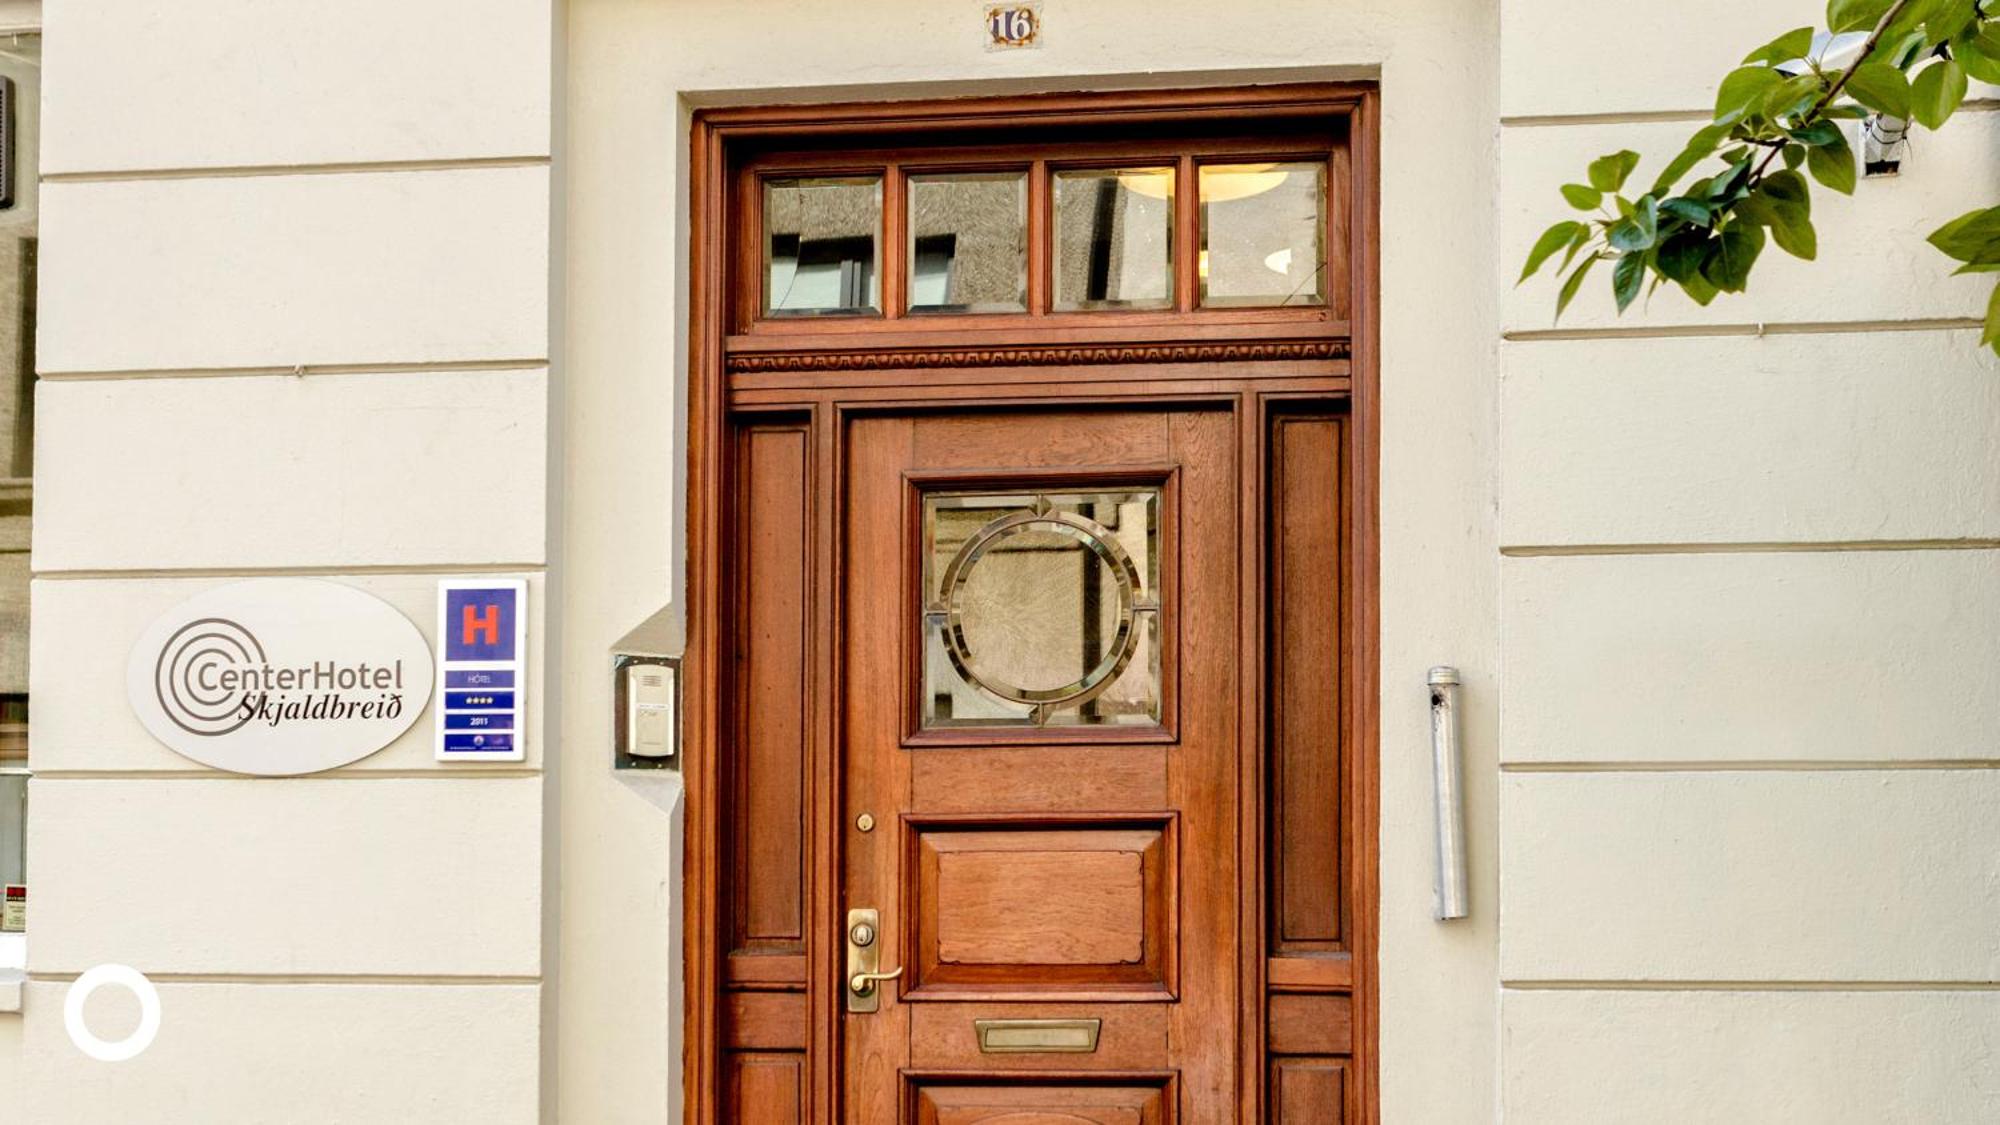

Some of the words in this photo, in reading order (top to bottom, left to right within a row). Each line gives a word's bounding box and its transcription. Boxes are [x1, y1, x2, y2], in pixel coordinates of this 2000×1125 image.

[993, 9, 1031, 40] 16
[462, 604, 498, 645] H
[199, 659, 403, 691] CenterHotel
[238, 692, 403, 727] Skjaldbreið
